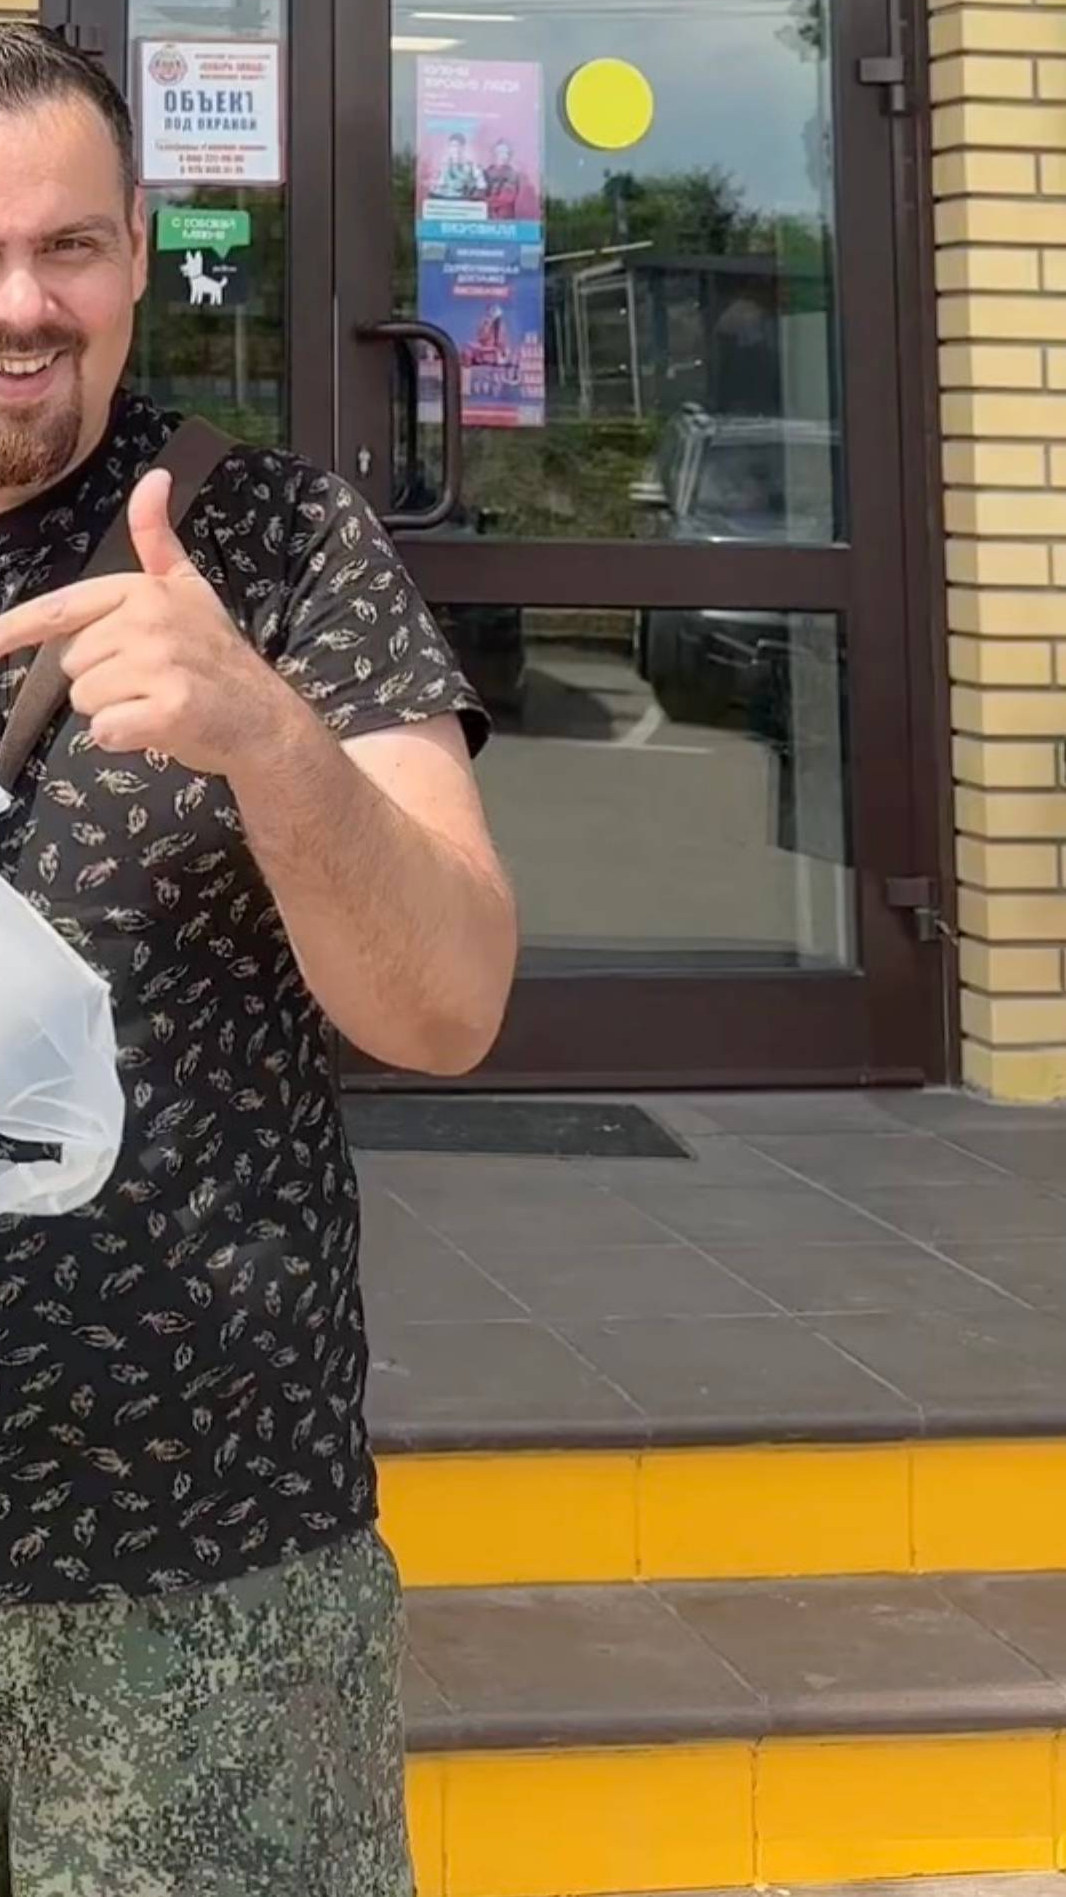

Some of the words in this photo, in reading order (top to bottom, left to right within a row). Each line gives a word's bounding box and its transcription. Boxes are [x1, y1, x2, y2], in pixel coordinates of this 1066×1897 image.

[164, 89, 254, 114] ОБЪЕКТ
[164, 117, 193, 132] ПОД
[197, 116, 257, 131] ОХРАНОЙ
